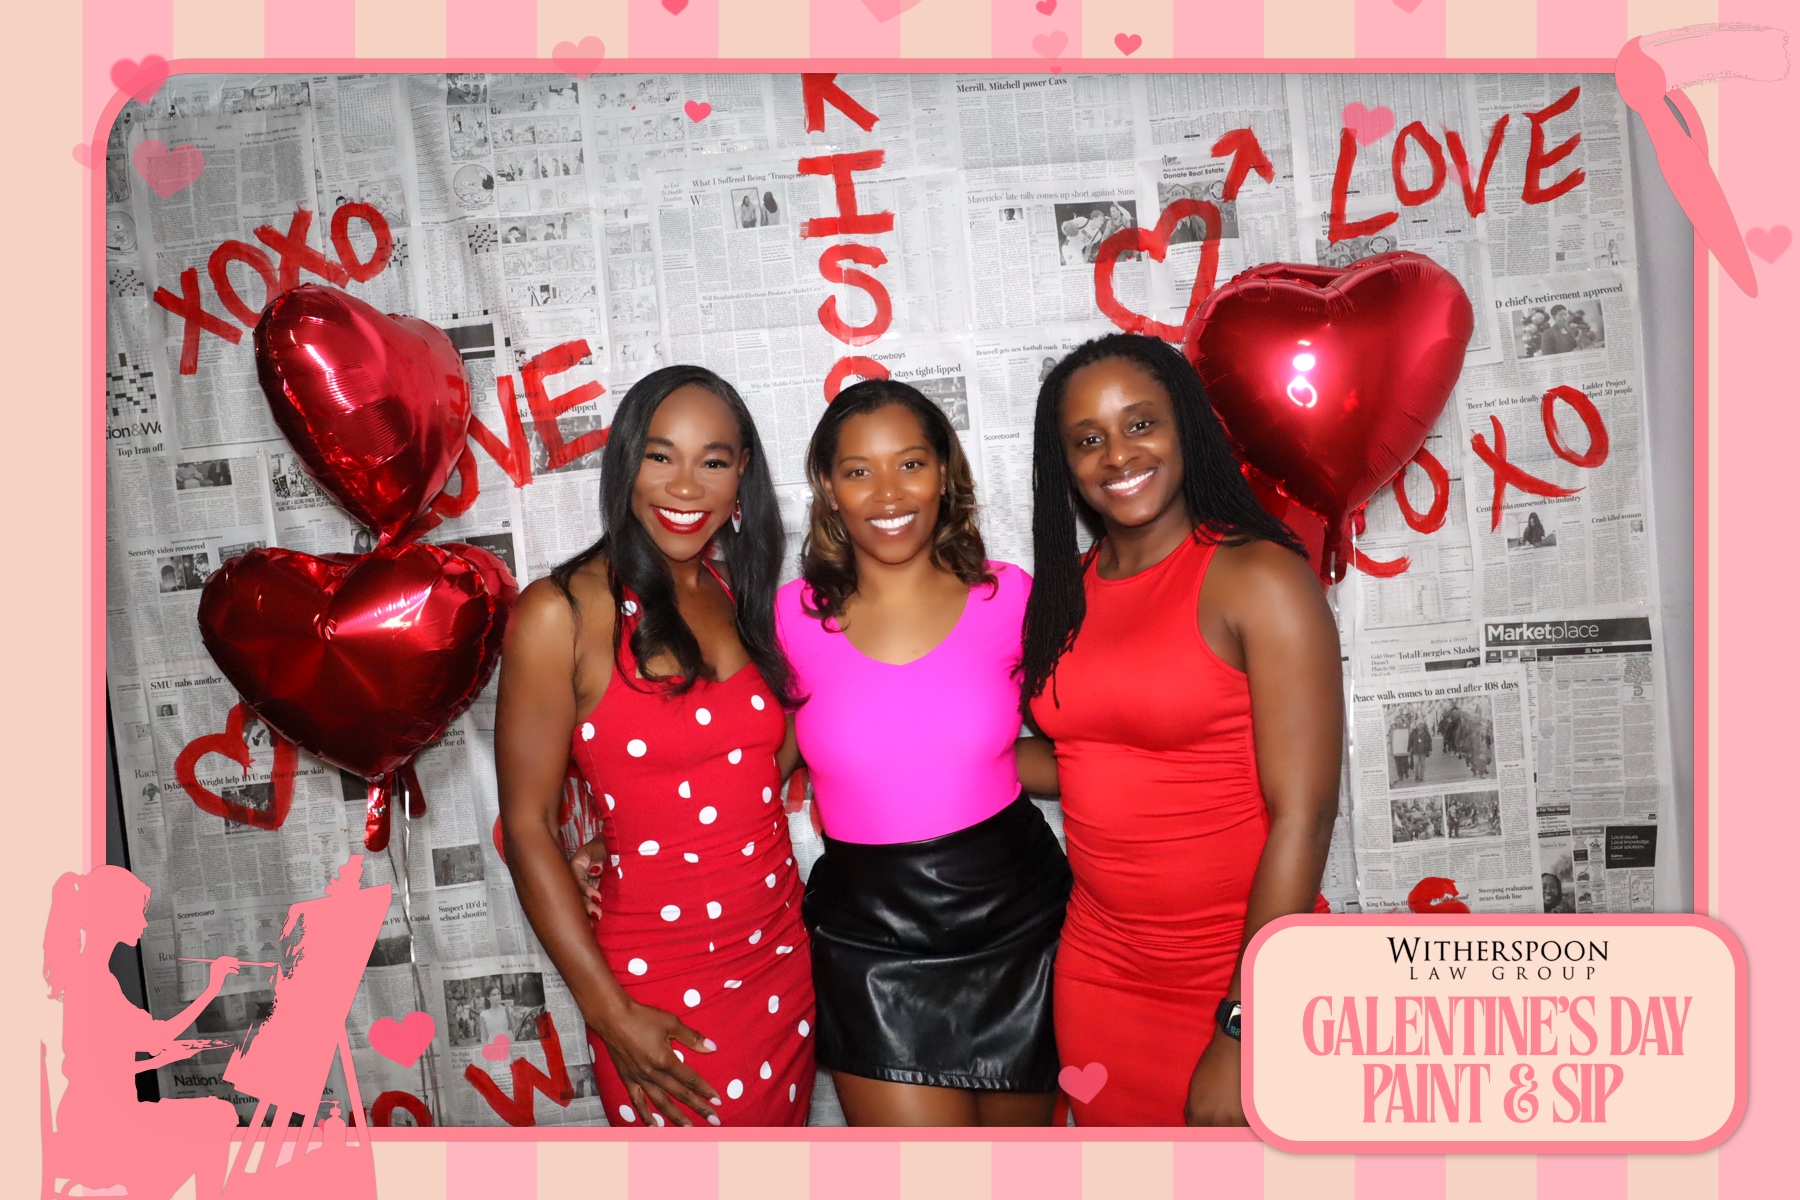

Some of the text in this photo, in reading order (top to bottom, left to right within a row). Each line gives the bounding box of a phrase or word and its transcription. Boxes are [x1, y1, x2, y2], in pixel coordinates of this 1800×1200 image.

[957, 76, 1067, 93] Merrill, Mitchell power Cavs
[1327, 86, 1586, 247] LOVE
[692, 179, 711, 187] What
[718, 175, 746, 184] Suffered
[747, 174, 766, 183] Being
[1164, 171, 1187, 179] Donate
[1188, 169, 1203, 177] Real
[967, 187, 1135, 204] Mavericks' late rally comes up short against Suns
[153, 200, 393, 376] XOXO
[1505, 295, 1533, 308] chief's
[1535, 290, 1581, 303] retirement
[1583, 283, 1623, 299] approved
[999, 347, 1010, 355] gets
[1022, 344, 1042, 352] football
[894, 369, 914, 380] stays
[915, 363, 961, 377] tight-lipped
[1582, 378, 1627, 390] Ladder Project
[1583, 389, 1603, 399] elped
[1613, 385, 1634, 395] people
[1466, 402, 1483, 410] 'Beer
[1484, 399, 1497, 408] bet'
[1498, 397, 1509, 406] led
[1519, 394, 1540, 404] deadly
[983, 432, 1019, 441] Scoreboard
[116, 443, 165, 457] Top Iran off
[1514, 499, 1548, 509] coursework
[1555, 495, 1581, 504] industry
[1591, 511, 1642, 524] Crash killed woman
[128, 542, 206, 558] Security video recovered
[528, 561, 550, 571] needed
[1487, 621, 1600, 642] Marketplace
[1399, 645, 1481, 660] TotalEnergies Slashes
[150, 675, 222, 690] SMU nabs another
[1353, 692, 1375, 702] Peace
[1377, 691, 1396, 700] walk
[1398, 689, 1422, 698] comes
[1424, 687, 1433, 696] to
[1446, 684, 1462, 694] end
[1463, 683, 1482, 693] after
[1484, 681, 1498, 691] 108
[1501, 680, 1519, 691] days
[444, 739, 455, 747] for
[199, 777, 224, 789] Wright
[225, 775, 240, 785] help
[242, 773, 258, 782] BYU
[260, 771, 273, 779] end
[310, 766, 325, 776] skid
[1478, 884, 1533, 895] Sweeping evaluation
[438, 901, 481, 914] Suspect ID'd
[1379, 899, 1400, 907] Charles
[177, 909, 215, 920] Scoreboard
[390, 914, 430, 925] FW Capitol
[440, 909, 487, 921] school shootin
